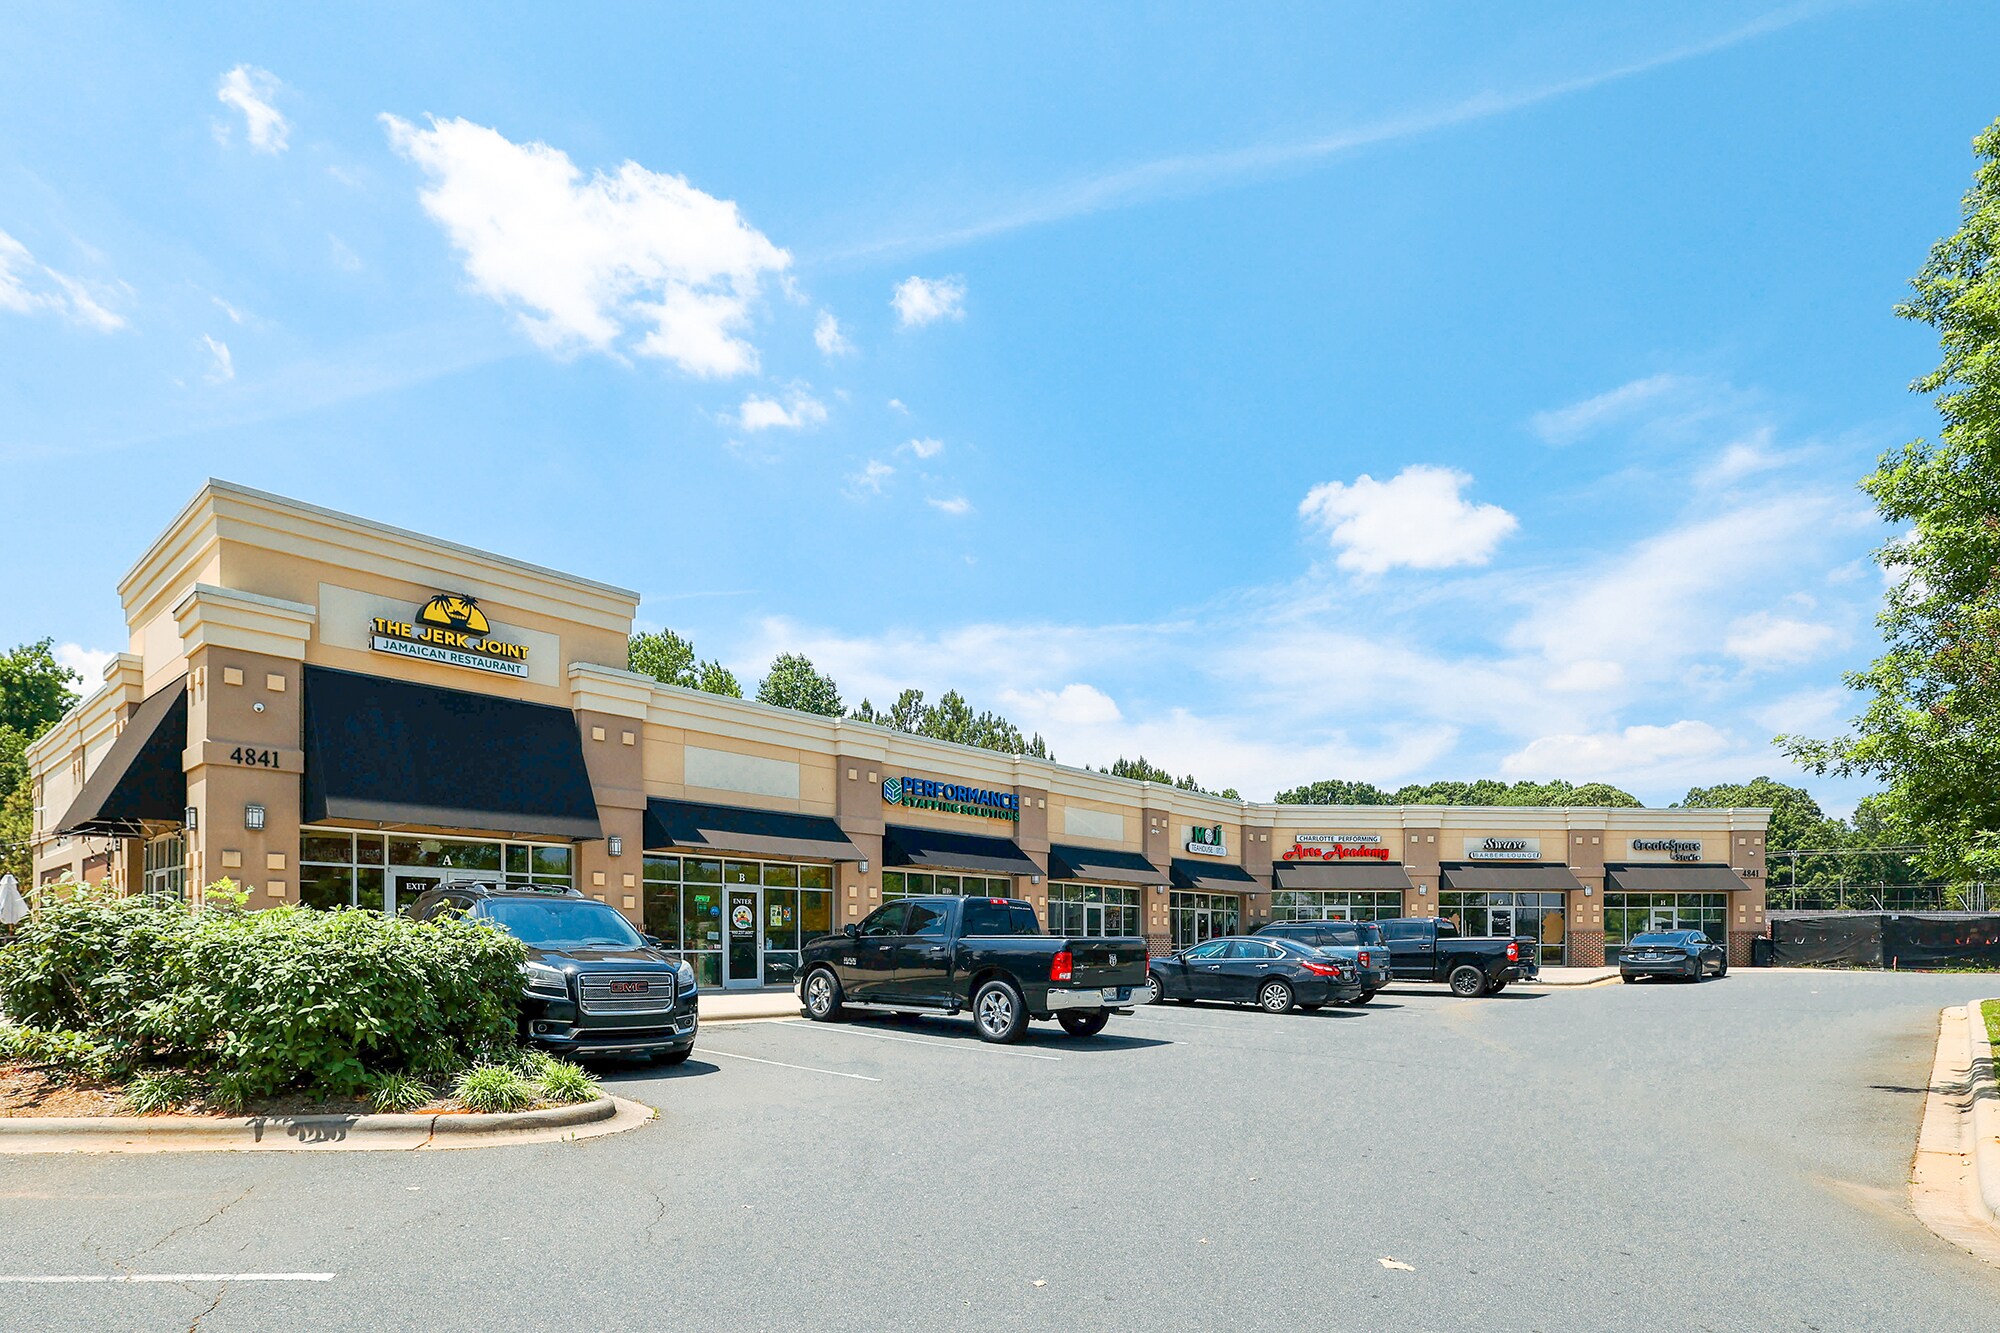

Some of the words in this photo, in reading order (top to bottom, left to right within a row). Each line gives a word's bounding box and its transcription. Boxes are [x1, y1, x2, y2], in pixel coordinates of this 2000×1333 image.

[373, 617, 412, 638] THE
[419, 627, 470, 649] JERK
[474, 638, 529, 660] JOINT
[383, 640, 446, 660] JAMAICAN
[450, 653, 521, 674] RESTAURANT
[230, 747, 280, 768] 4841
[901, 776, 1019, 810] PERFORMANCE
[901, 796, 960, 813] STAFFING
[960, 804, 1019, 822] SOLUTIONS
[1191, 844, 1214, 853] TEAHOUSE
[1282, 843, 1322, 860] Arts
[1323, 843, 1389, 861] Academy
[442, 855, 453, 866] A
[739, 873, 745, 882] B
[1743, 869, 1759, 877] 4841
[405, 882, 427, 890] EXIT
[611, 982, 648, 992] GMC
